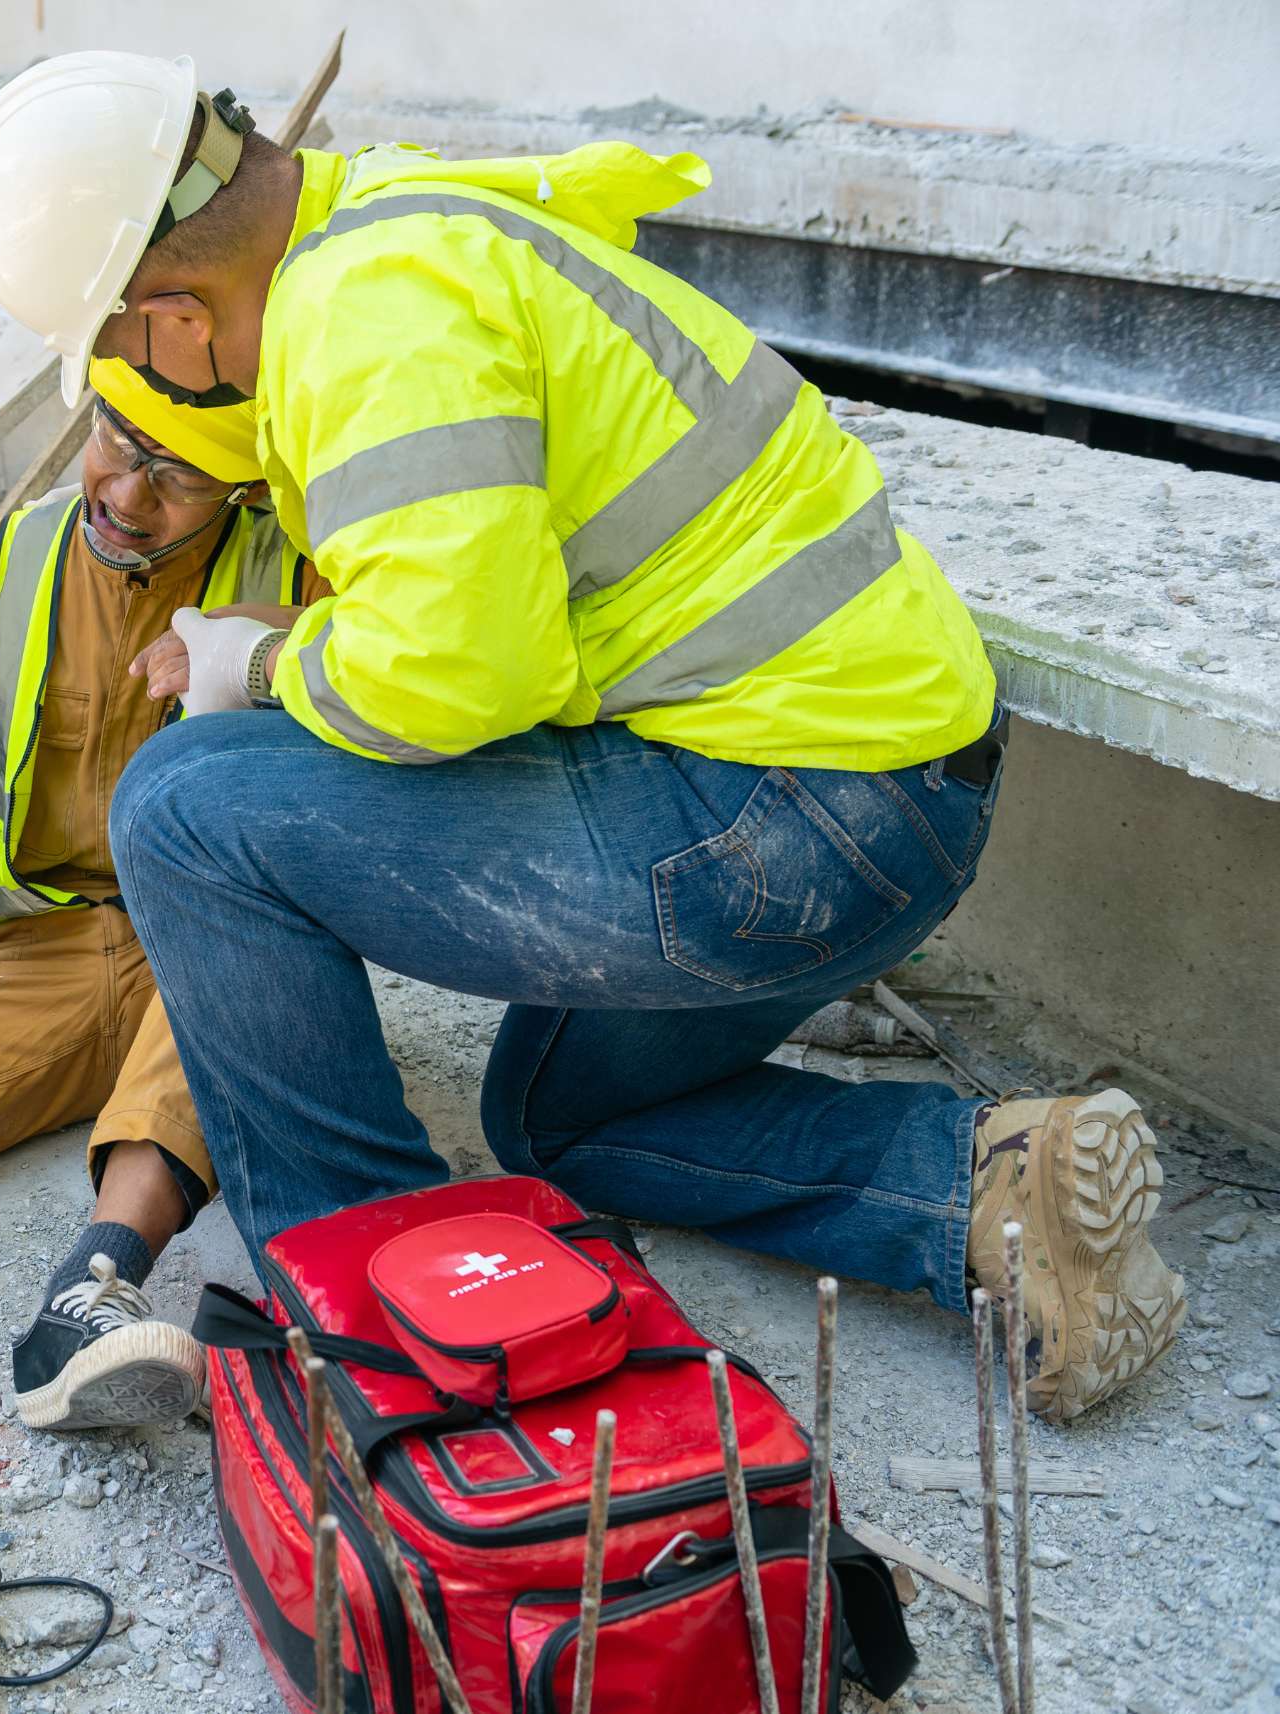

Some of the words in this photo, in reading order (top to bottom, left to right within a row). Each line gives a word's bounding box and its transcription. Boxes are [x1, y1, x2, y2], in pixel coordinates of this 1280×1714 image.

[448, 1278, 489, 1297] FIRST
[494, 1270, 518, 1281] AID
[520, 1261, 544, 1272] KIT
